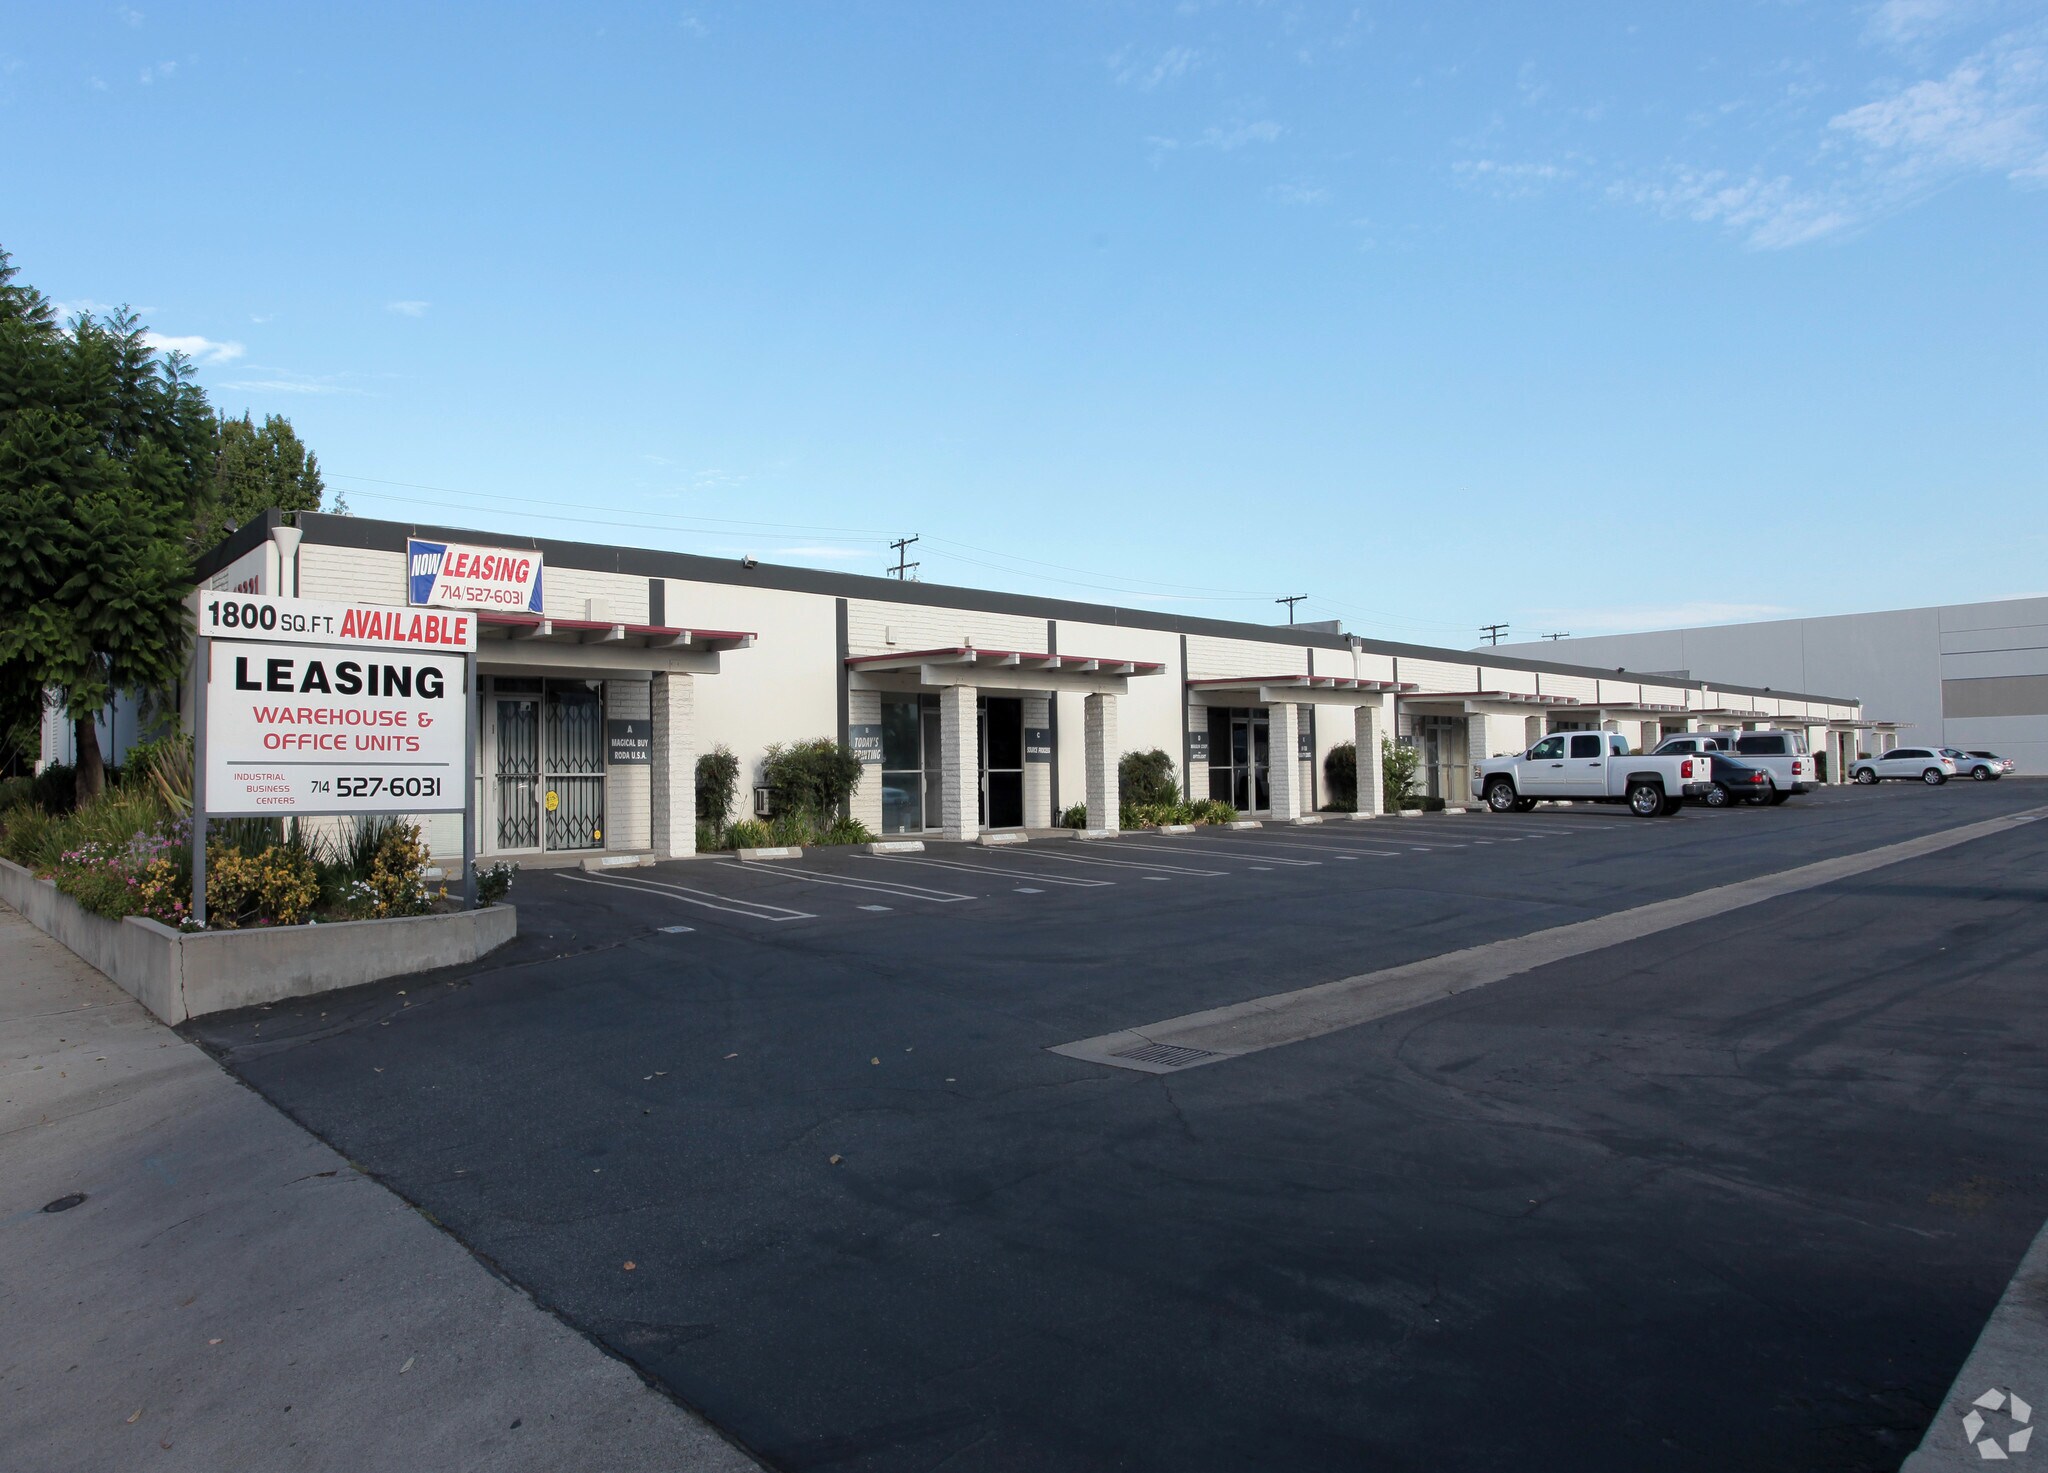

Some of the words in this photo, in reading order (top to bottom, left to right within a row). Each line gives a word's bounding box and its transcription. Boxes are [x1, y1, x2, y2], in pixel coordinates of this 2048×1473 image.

[411, 553, 441, 577] NOW
[443, 552, 530, 583] LEASING
[441, 585, 523, 605] 714/527-6031
[208, 600, 277, 631] 1800
[340, 608, 468, 646] AVAILABLE
[235, 656, 444, 699] LEASING
[253, 706, 407, 727] WAREHOUSE
[417, 712, 433, 728] &
[627, 725, 633, 734] A
[263, 733, 347, 751] OFFICE
[355, 734, 420, 752] UNITS
[611, 738, 636, 747] MAGICAL
[637, 738, 649, 747] BUY
[854, 737, 880, 748] TODAY'S
[614, 751, 630, 760] RODA
[234, 773, 286, 782] INDUSTRIAL
[246, 785, 290, 793] BUSINESS
[311, 780, 330, 794] 714
[336, 777, 441, 797] 527-6031
[256, 797, 295, 805] CENTERS
